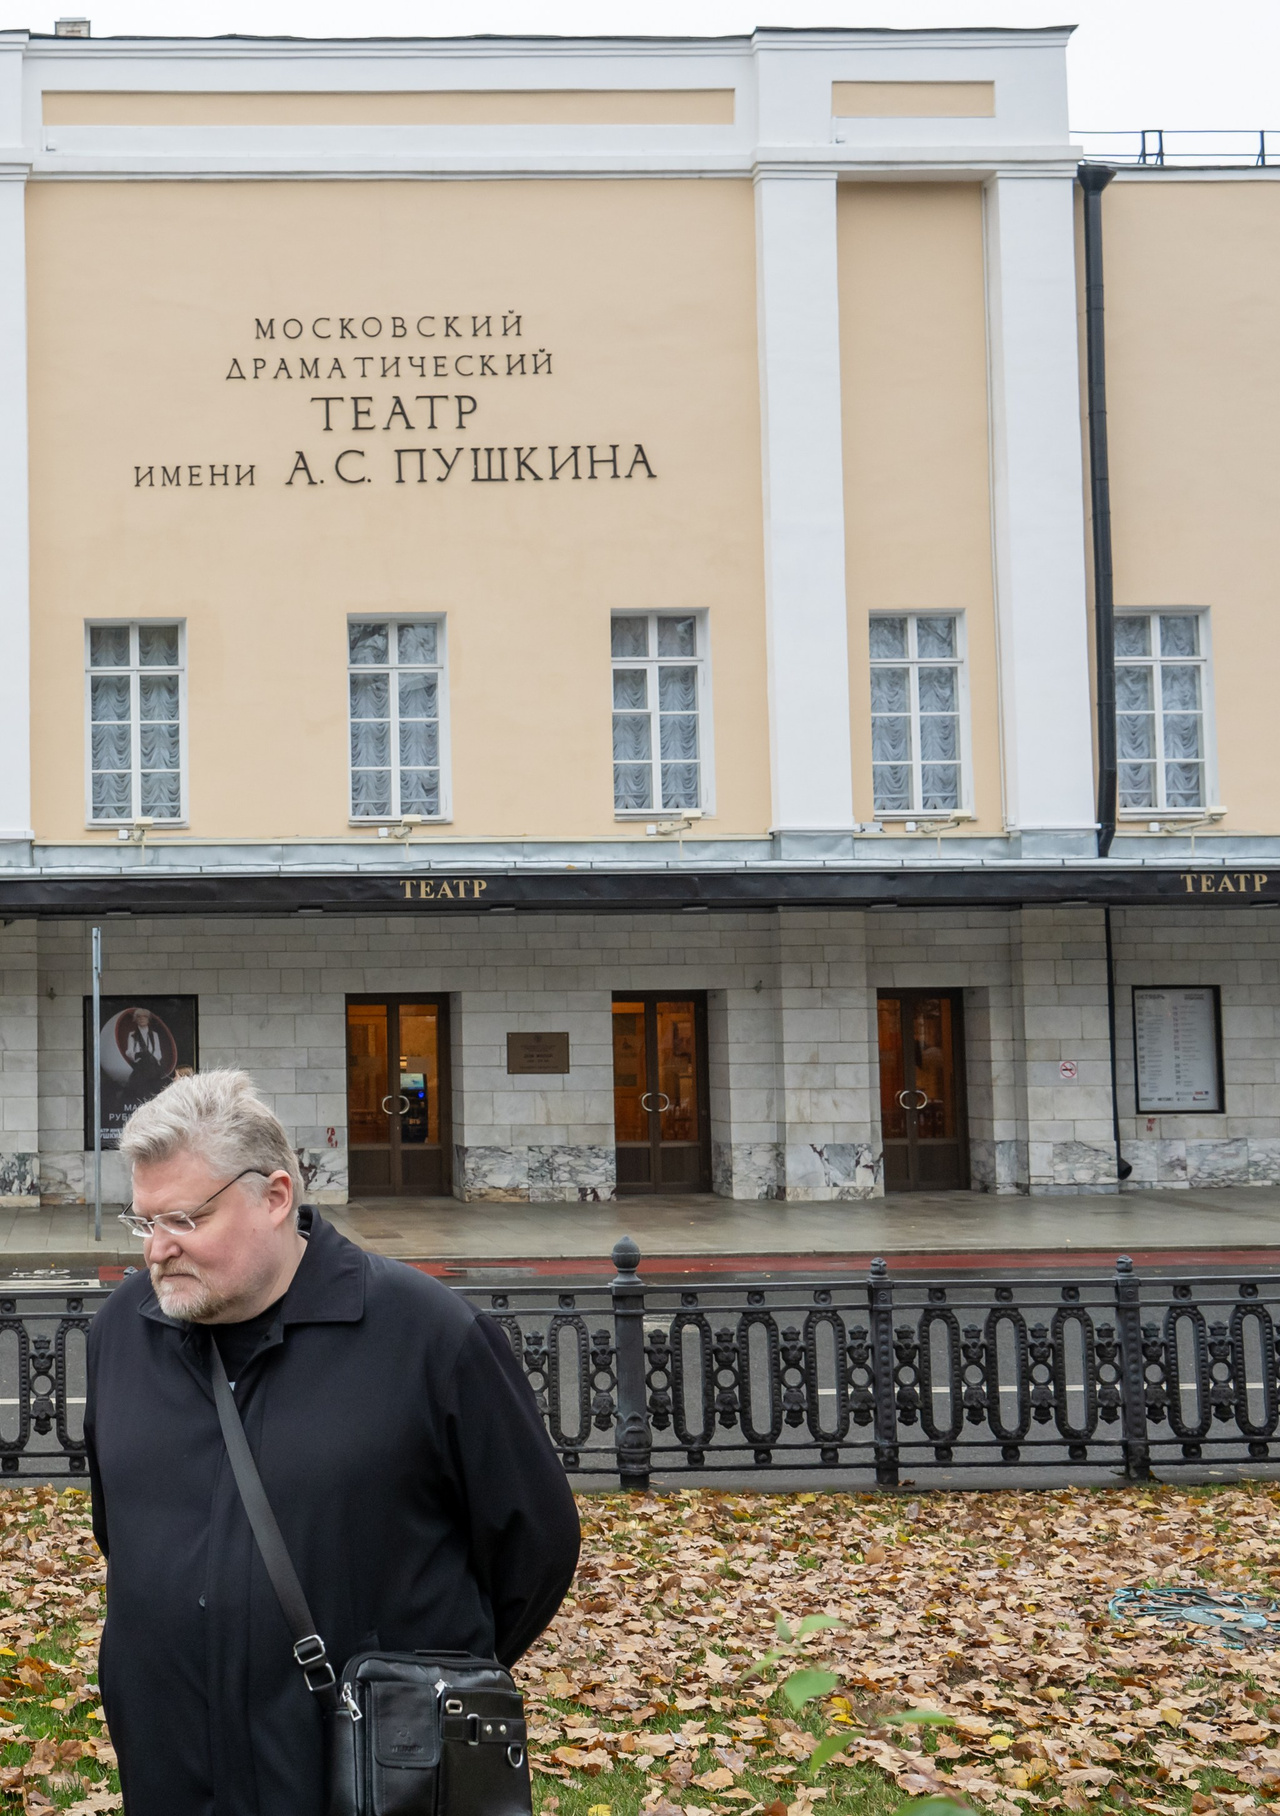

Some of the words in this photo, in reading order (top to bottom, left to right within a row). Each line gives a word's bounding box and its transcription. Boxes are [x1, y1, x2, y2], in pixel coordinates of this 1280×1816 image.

[254, 310, 523, 340] МОСКОВСКИЙ
[225, 348, 554, 380] ДРАМАТИЧЕСКИЙ
[310, 395, 478, 431] ТЕАТР
[133, 464, 256, 487] ИМЕНИ
[393, 443, 658, 484] ПУШКИНА
[399, 879, 488, 899] ТЕАТР
[1180, 873, 1268, 893] ТЕАТР
